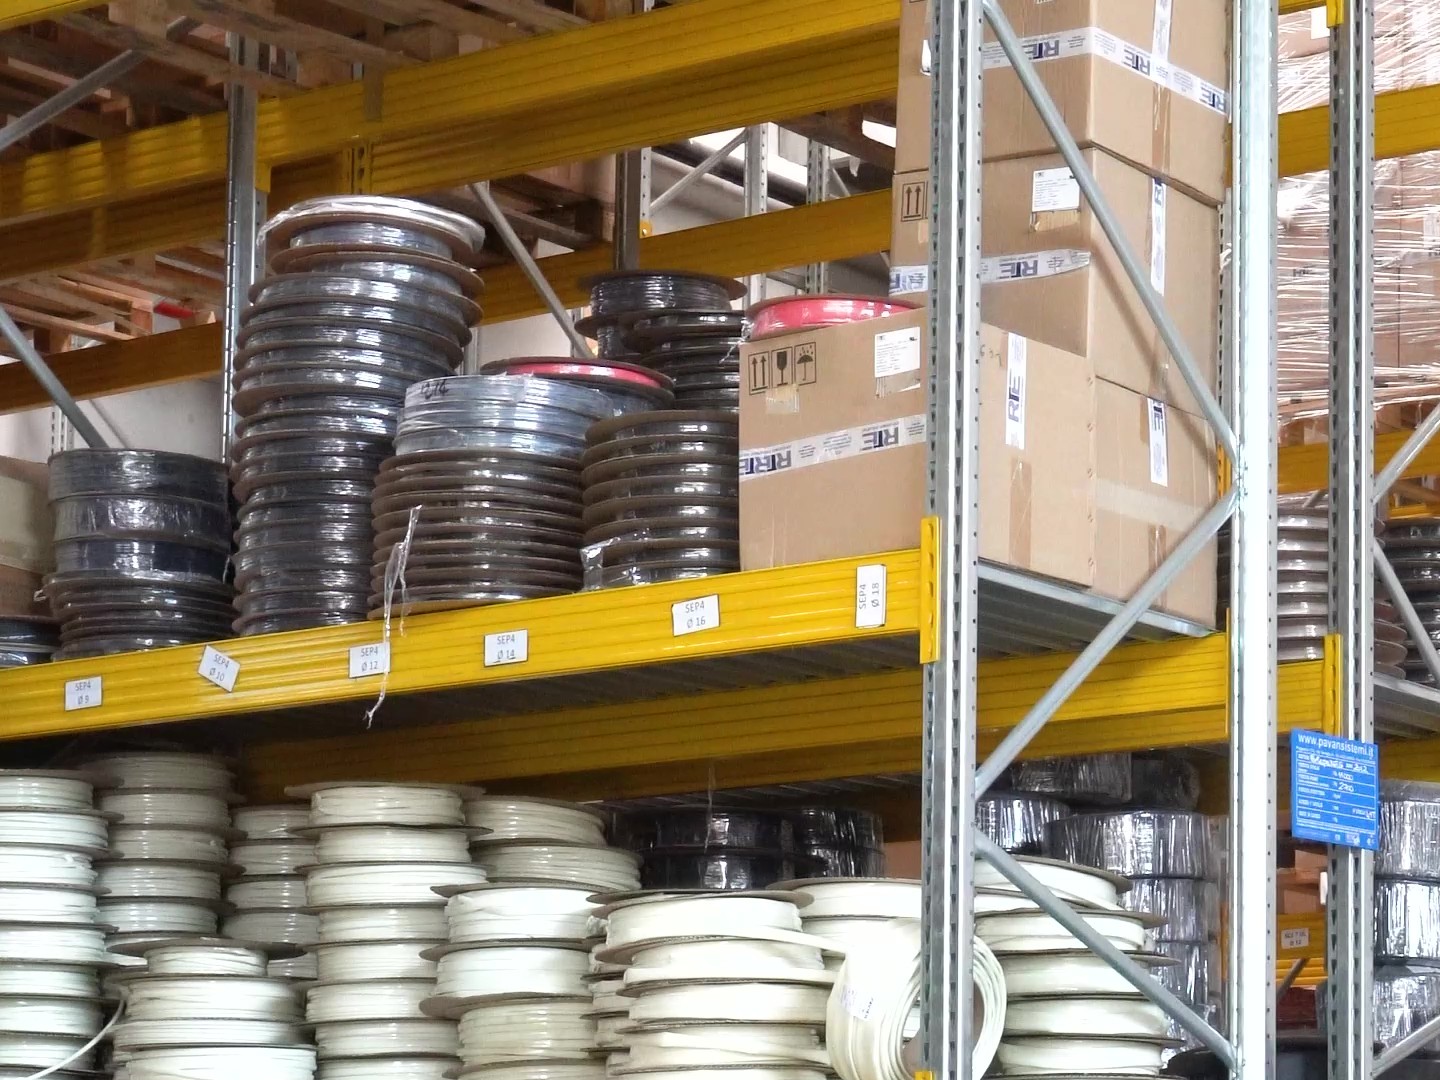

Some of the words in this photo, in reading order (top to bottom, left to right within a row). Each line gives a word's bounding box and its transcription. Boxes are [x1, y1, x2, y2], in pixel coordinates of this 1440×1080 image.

[996, 259, 1038, 279] RTE
[1008, 368, 1023, 423] RTE
[860, 426, 900, 451] RTE
[872, 582, 880, 597] 18
[859, 583, 867, 610] SEP4
[685, 600, 705, 613] SEP4
[696, 616, 706, 627] 16
[497, 634, 515, 645] SEP4
[361, 646, 379, 657] SEP4
[505, 649, 515, 659] 14
[214, 653, 230, 669] SEP4
[369, 660, 378, 670] 12
[216, 671, 225, 682] 10
[75, 681, 91, 692] SEP4
[84, 694, 90, 704] 9
[1298, 733, 1374, 760] www.pavansistemi.it
